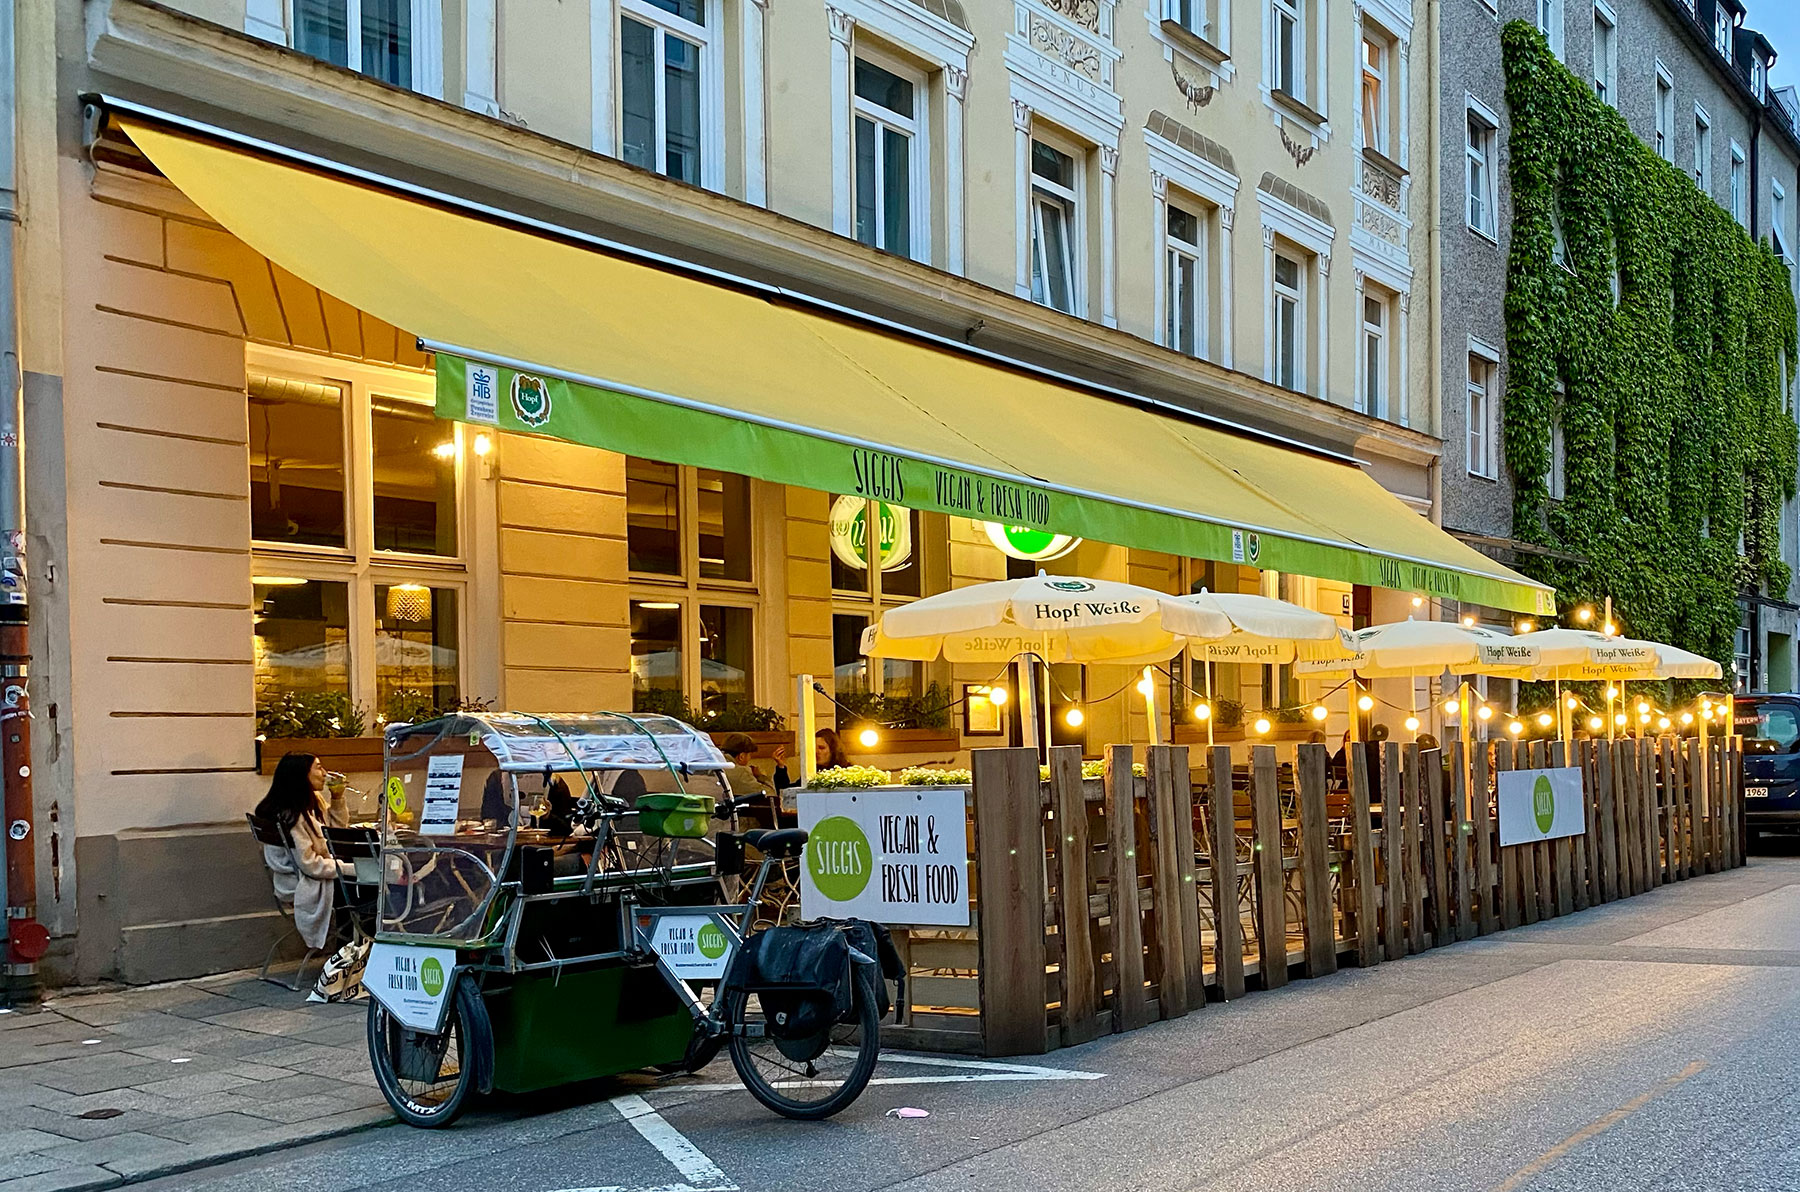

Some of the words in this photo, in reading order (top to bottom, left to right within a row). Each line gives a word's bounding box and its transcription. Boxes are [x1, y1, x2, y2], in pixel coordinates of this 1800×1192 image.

[1037, 57, 1096, 98] VENUS
[521, 392, 540, 405] Hopf
[853, 449, 905, 503] SIGGIS
[935, 471, 971, 511] VEGAN
[976, 480, 985, 513] &
[991, 482, 1023, 520] FRESH
[1027, 490, 1050, 525] FOOD
[1035, 603, 1081, 622] Hopf
[1085, 601, 1141, 616] Weiße
[1486, 645, 1505, 660] Hopf
[1505, 646, 1532, 657] Weiße
[1596, 648, 1617, 660] Hopf
[1618, 647, 1646, 657] Weiße
[1582, 665, 1608, 676] Hopf
[1746, 788, 1767, 797] 1962
[879, 815, 920, 854] VEGAN
[927, 815, 940, 855] &
[816, 840, 862, 875] SIGGIS
[881, 863, 920, 904] FRESH
[926, 864, 959, 904] FOOD
[702, 933, 724, 949] SIGGIS
[423, 967, 441, 985] SIGGIS
[406, 1100, 438, 1115] MTX
